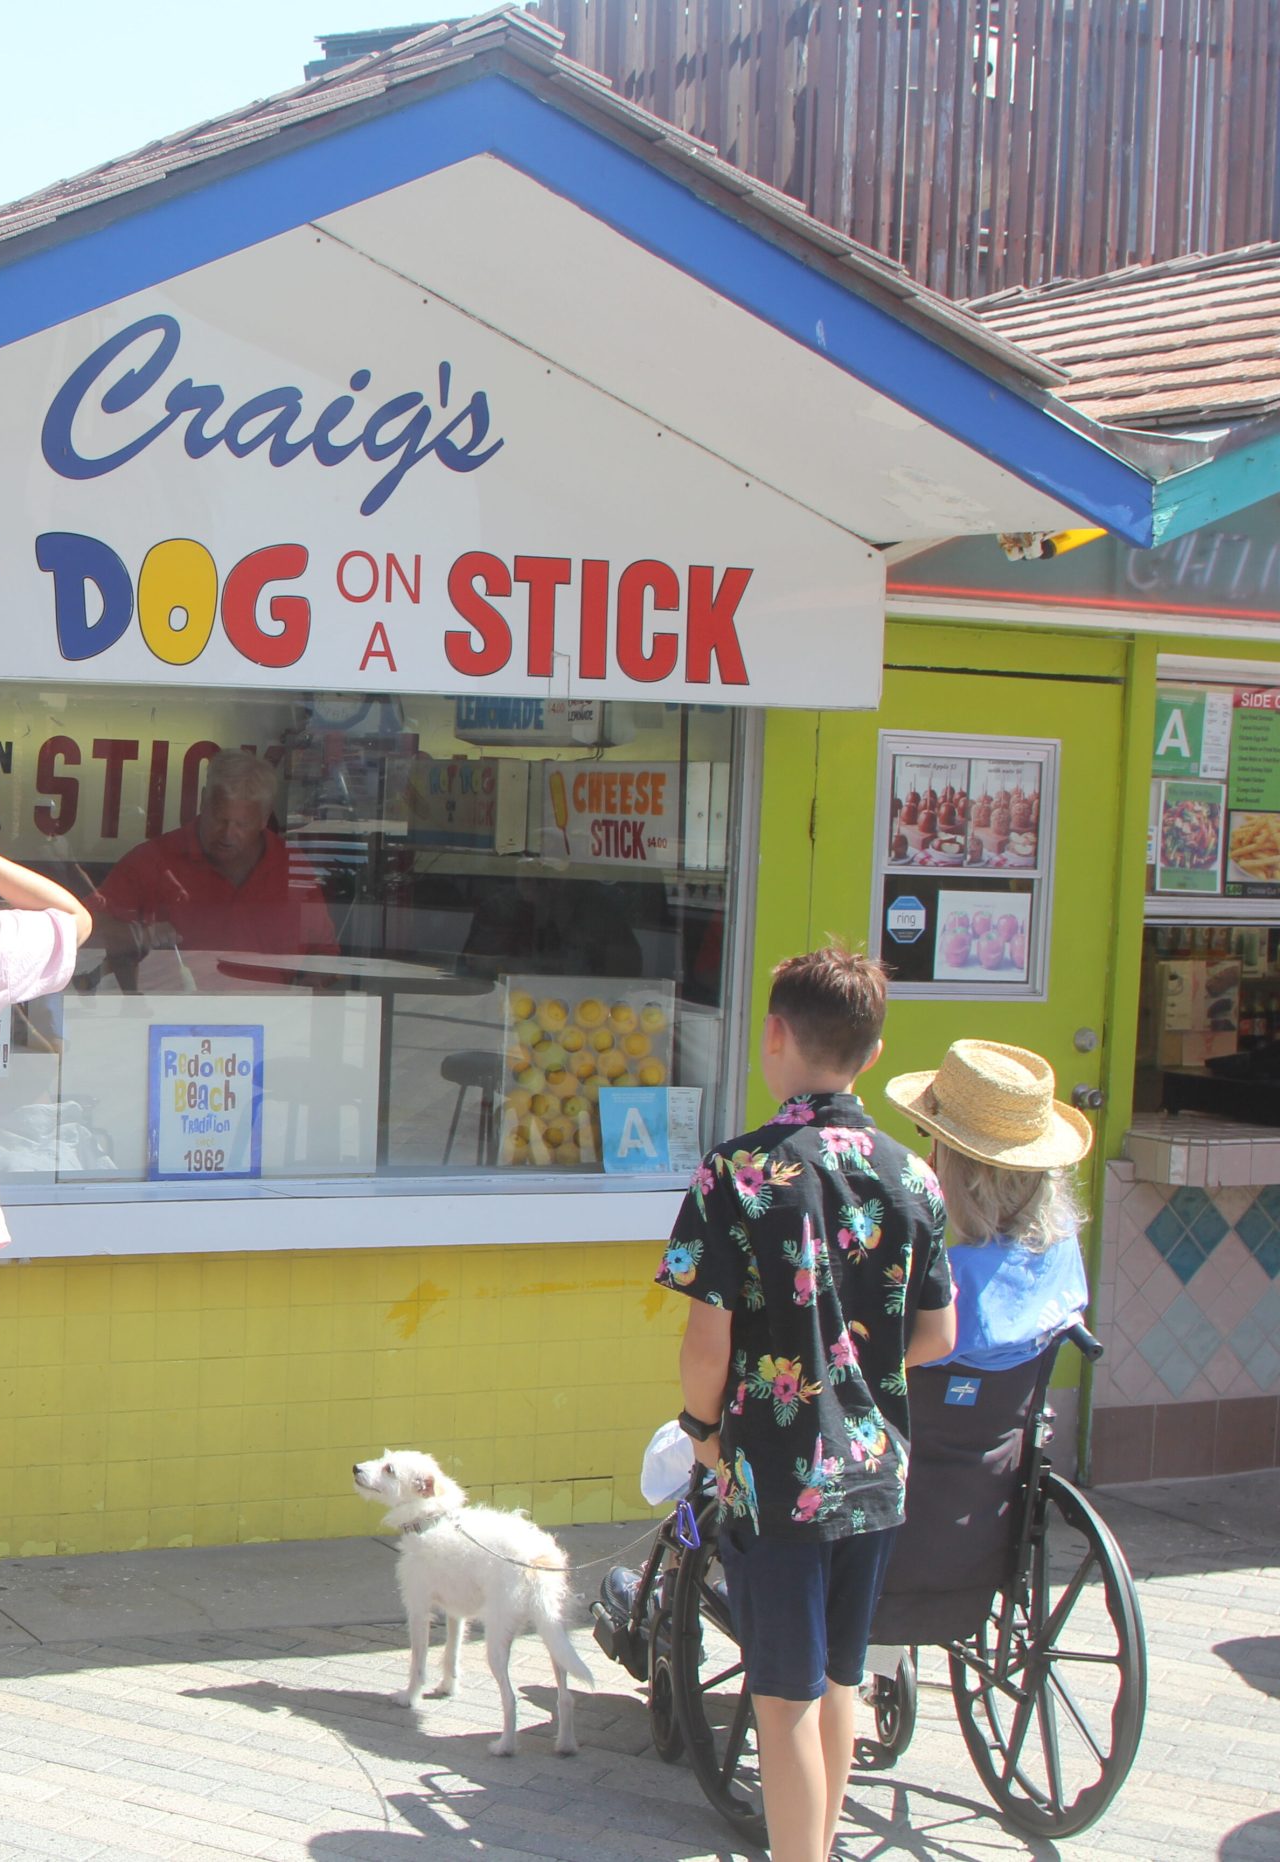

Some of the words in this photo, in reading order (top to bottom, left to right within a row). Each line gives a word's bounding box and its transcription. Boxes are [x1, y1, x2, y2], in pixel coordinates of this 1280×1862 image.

[41, 314, 505, 517] Craig's
[35, 531, 310, 668] DOG
[336, 550, 421, 605] ON
[442, 550, 754, 687] STICK
[359, 621, 398, 673] A
[1241, 692, 1271, 708] SIDE
[1155, 708, 1191, 757] A
[33, 734, 286, 842] STIC
[573, 770, 667, 816] CHEESE
[591, 819, 647, 860] STICK
[896, 912, 916, 927] ring
[164, 1050, 251, 1078] Redondo
[201, 1039, 211, 1055] a
[175, 1080, 236, 1112] Beach
[617, 1107, 658, 1157] A
[184, 1150, 225, 1172] 1962
